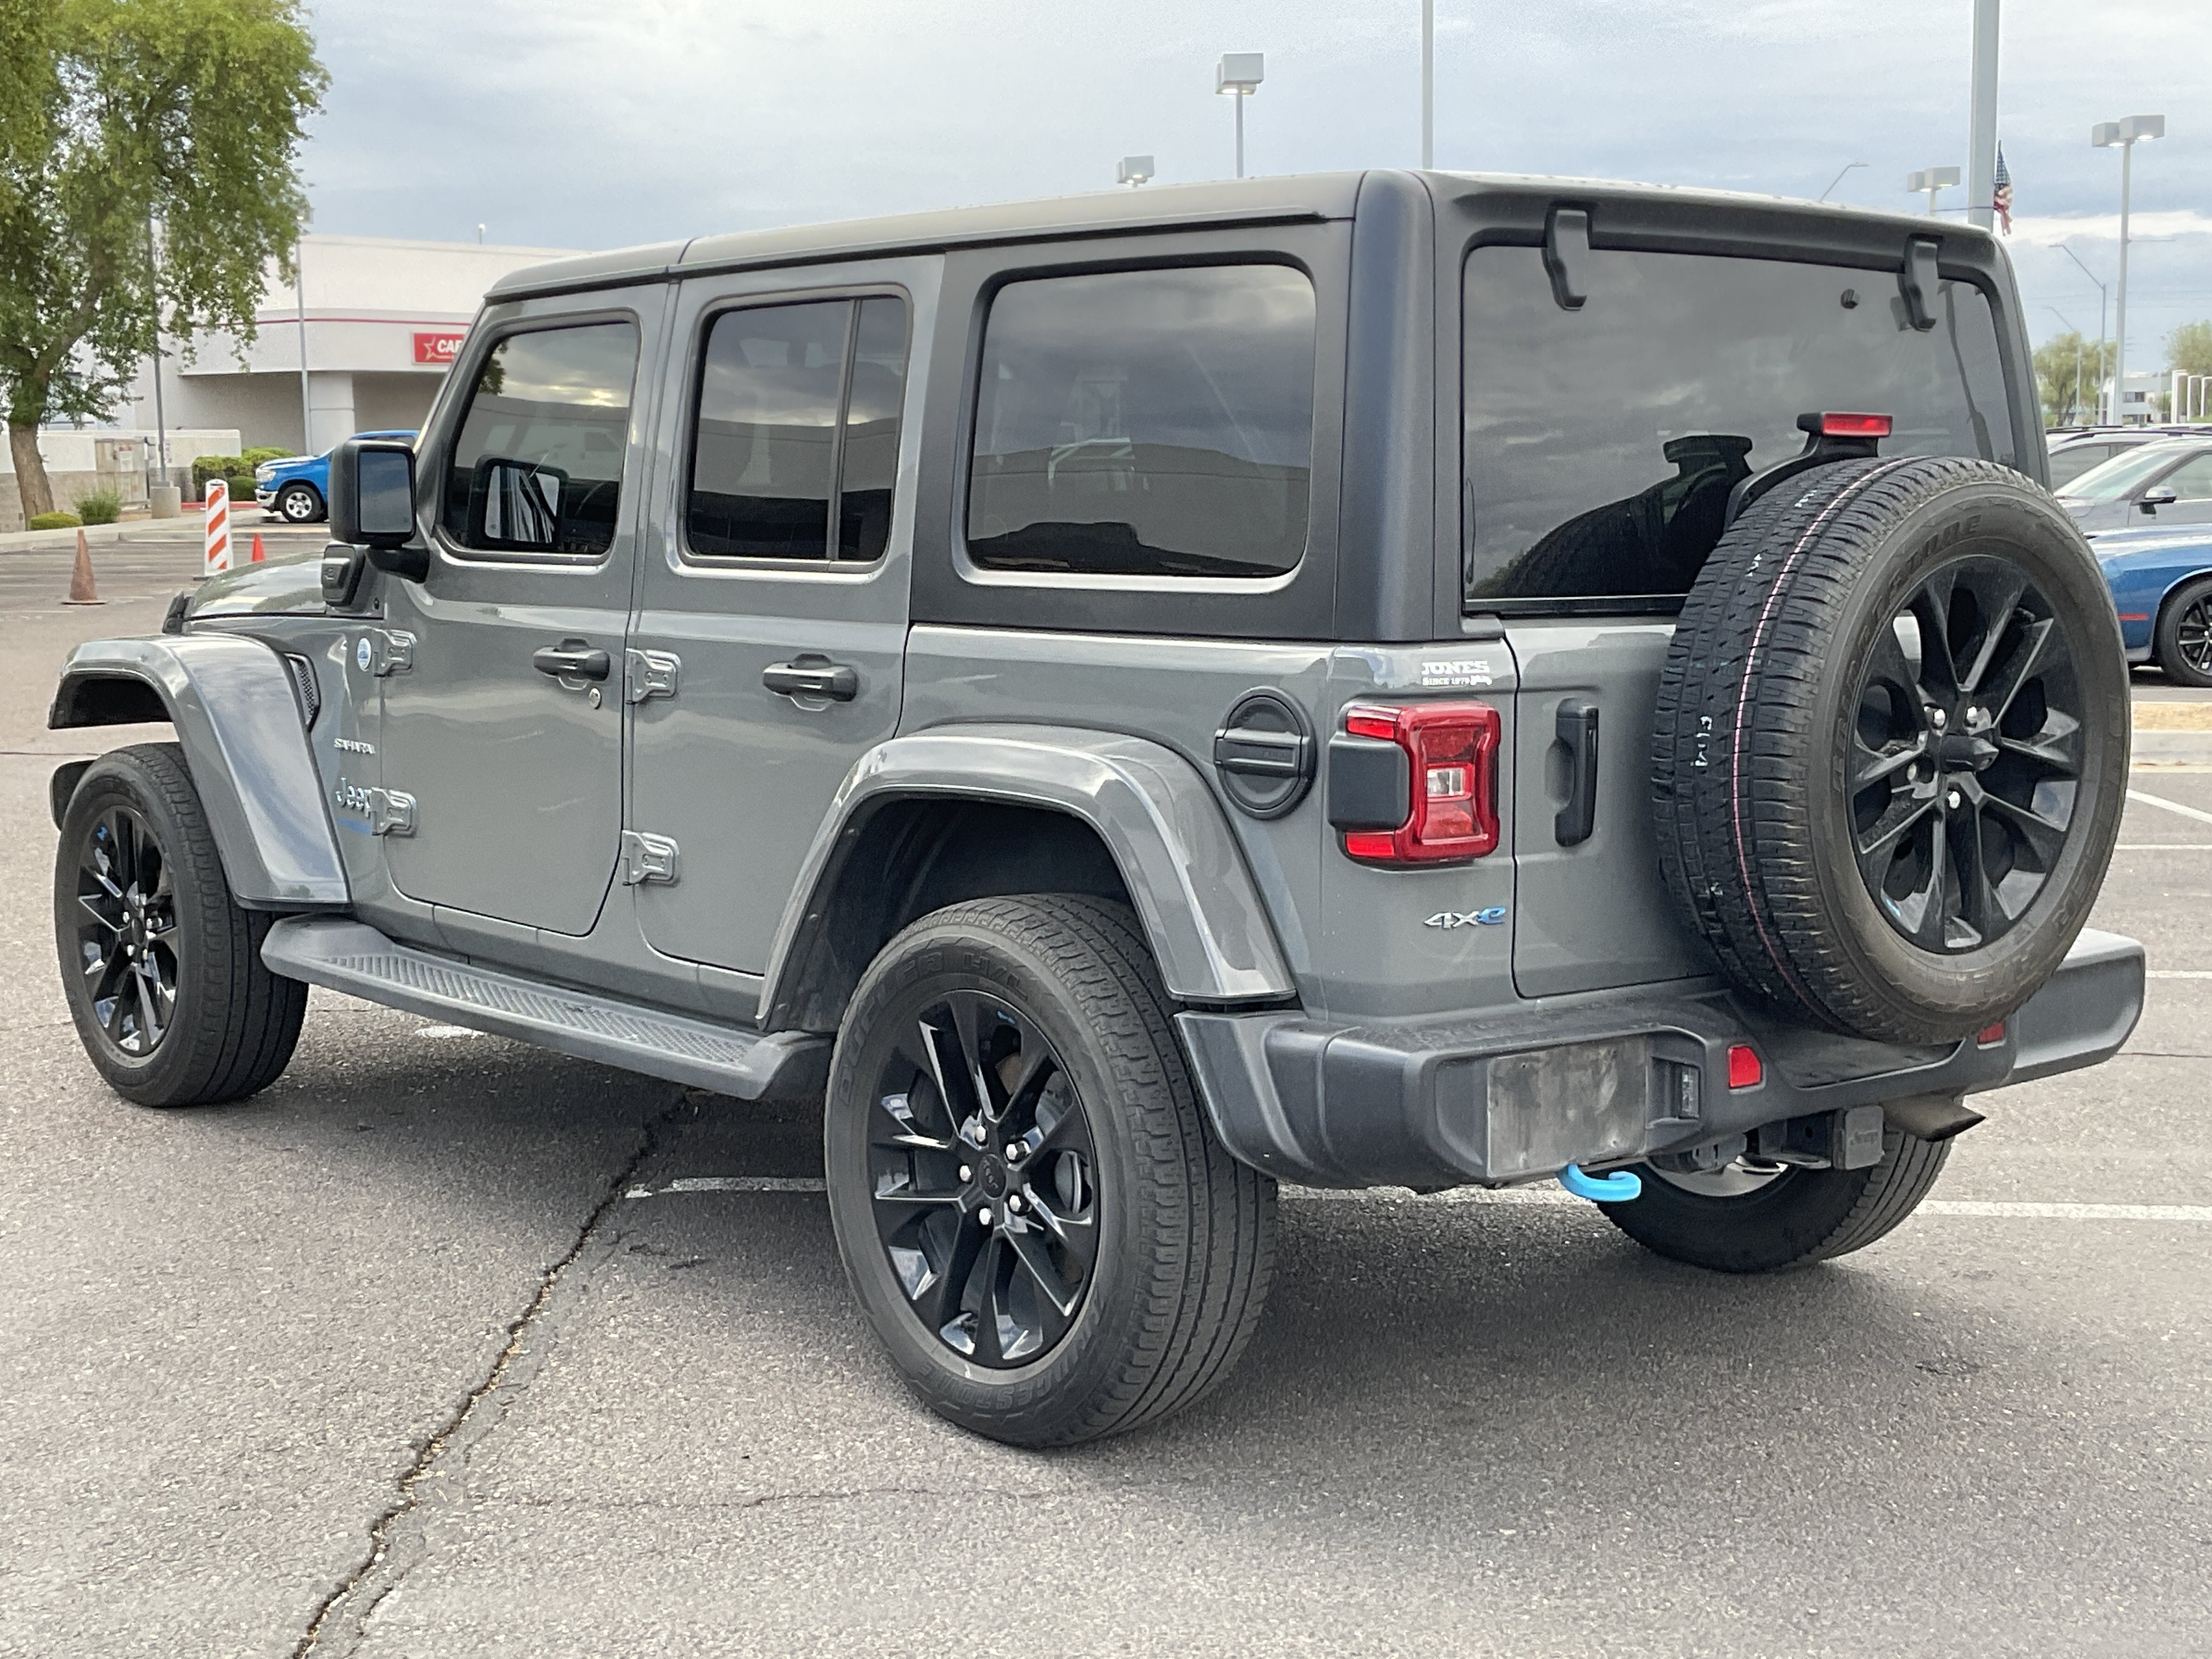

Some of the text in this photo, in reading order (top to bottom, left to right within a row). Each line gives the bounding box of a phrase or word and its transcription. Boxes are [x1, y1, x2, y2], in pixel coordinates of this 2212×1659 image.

[1421, 661, 1490, 675] JONES
[1422, 677, 1449, 686] SINCE
[334, 738, 376, 754] SAHARA
